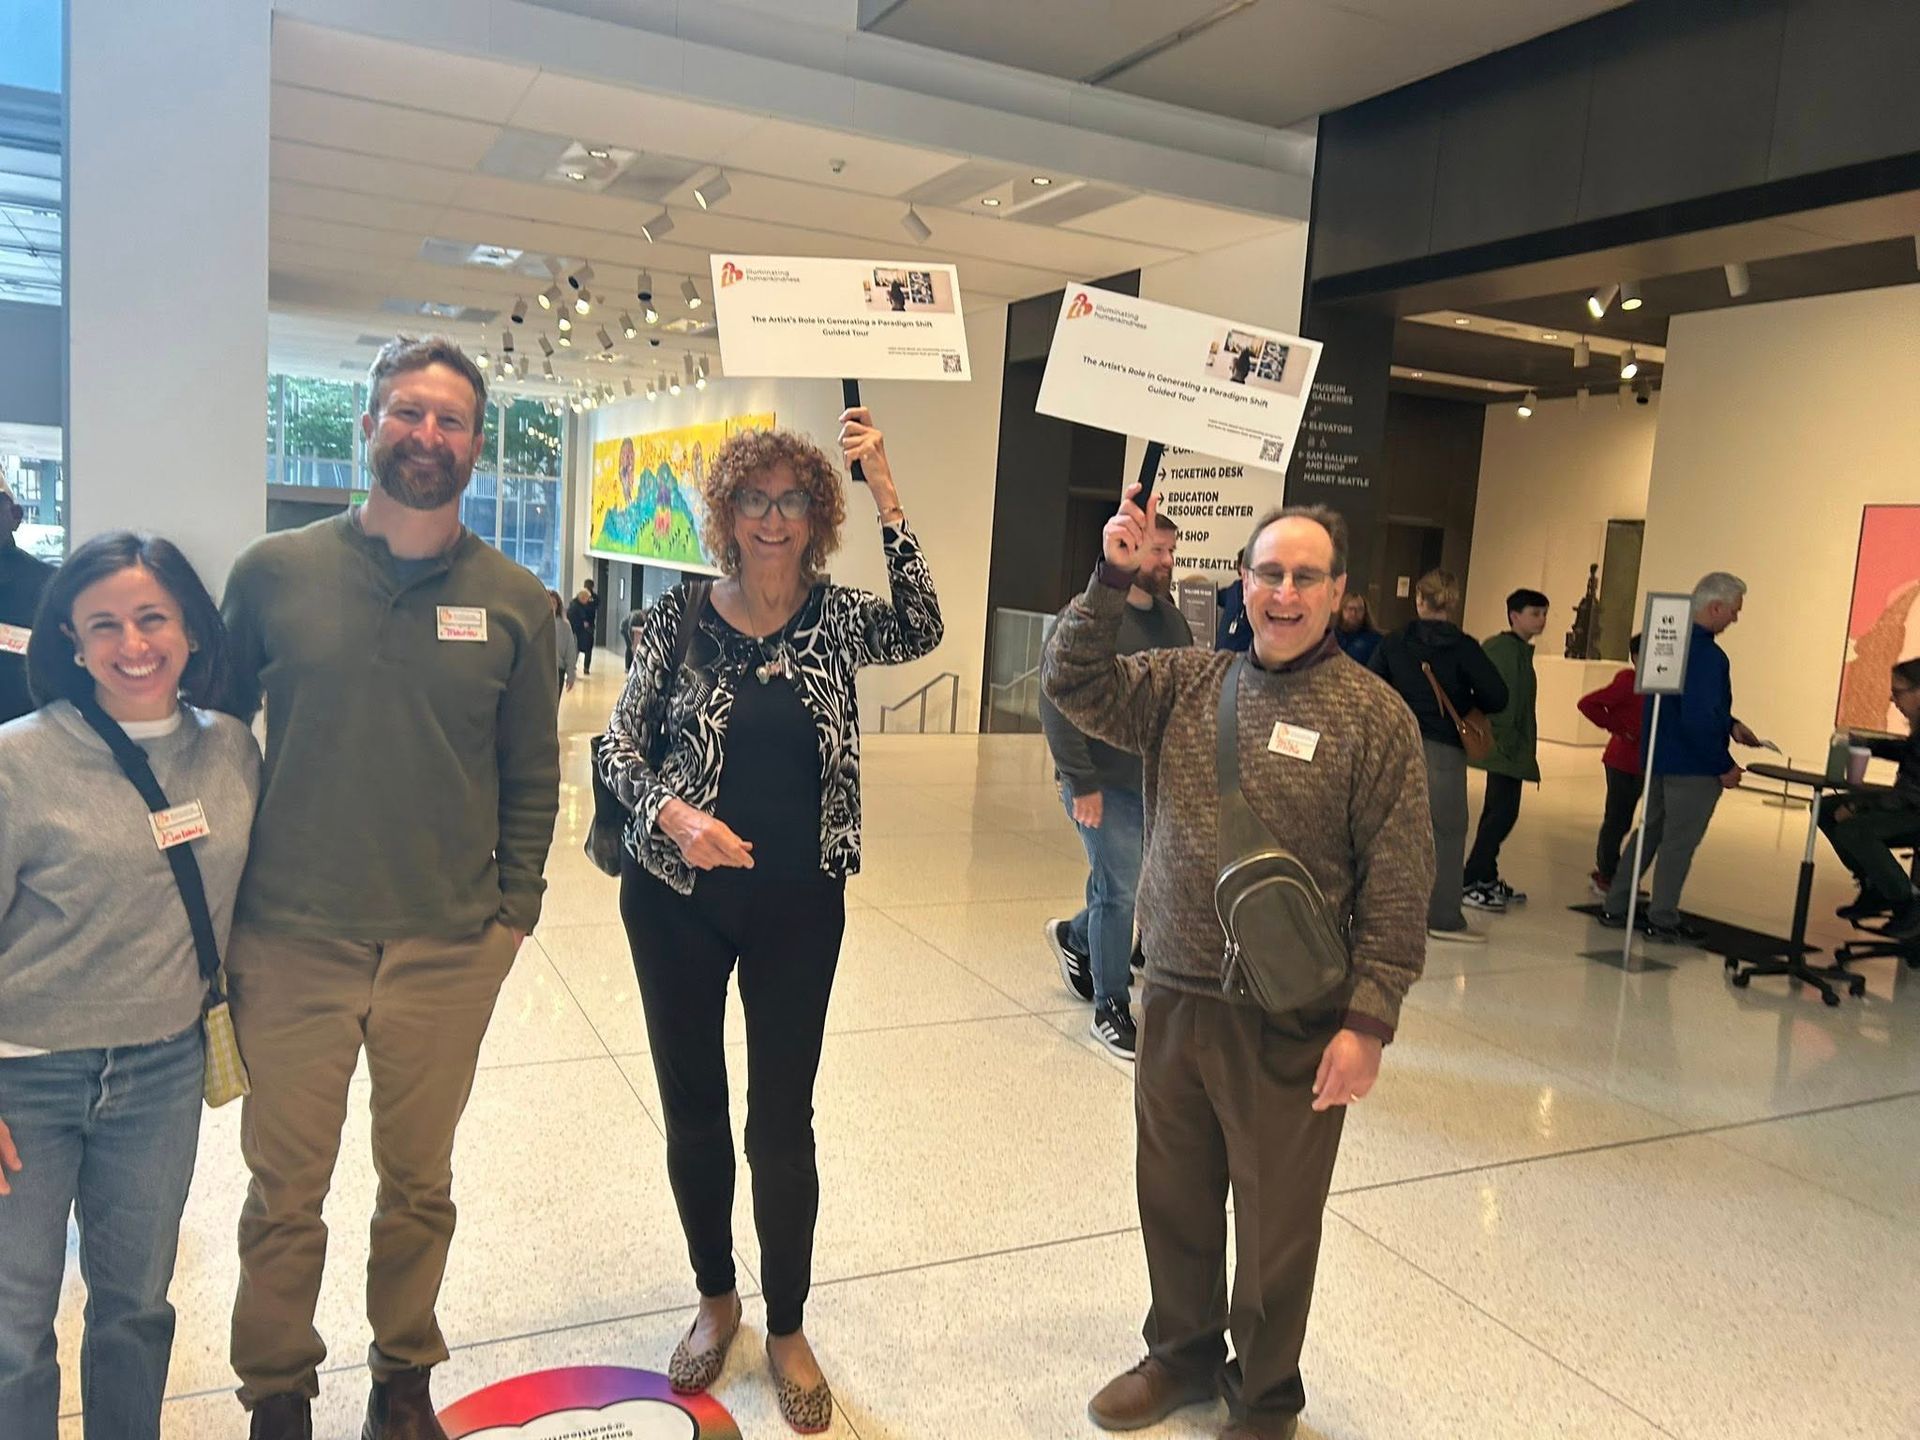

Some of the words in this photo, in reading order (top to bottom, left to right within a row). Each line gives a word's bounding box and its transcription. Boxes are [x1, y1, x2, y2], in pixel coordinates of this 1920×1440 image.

[752, 315, 766, 323] The
[768, 316, 796, 324] Artist's
[826, 317, 870, 327] Generating
[877, 319, 914, 328] Paradigm
[915, 320, 933, 328] Shift
[822, 328, 851, 337] Guided
[852, 329, 869, 337] Tour
[1083, 355, 1097, 366] The
[1099, 360, 1126, 373] Artist's
[1128, 367, 1146, 378] Role
[1147, 372, 1155, 380] in
[1156, 373, 1201, 393] Generating
[1209, 387, 1248, 403] Paradigm
[1249, 396, 1269, 408] Shift
[1147, 385, 1176, 398] Guided
[1178, 392, 1196, 403] Tour
[1312, 383, 1346, 394] MUSEUM
[1311, 392, 1353, 405] GALLERIES
[1309, 422, 1353, 434] ELEVATORS
[1324, 453, 1358, 464] GALLERY
[1305, 460, 1322, 470] AND
[1324, 462, 1345, 472] SHOP
[1170, 467, 1217, 480] TICKETING
[1218, 466, 1244, 478] DESK
[1303, 473, 1336, 485] MARKET
[1337, 476, 1370, 487] SEATTLE
[1168, 491, 1219, 502] EDUCATION
[1167, 505, 1214, 516] RESOURCE
[1215, 505, 1254, 517] CENTER
[1185, 530, 1210, 542] SHOP
[1175, 557, 1198, 568] RKET
[1200, 557, 1239, 571] SEATTLE
